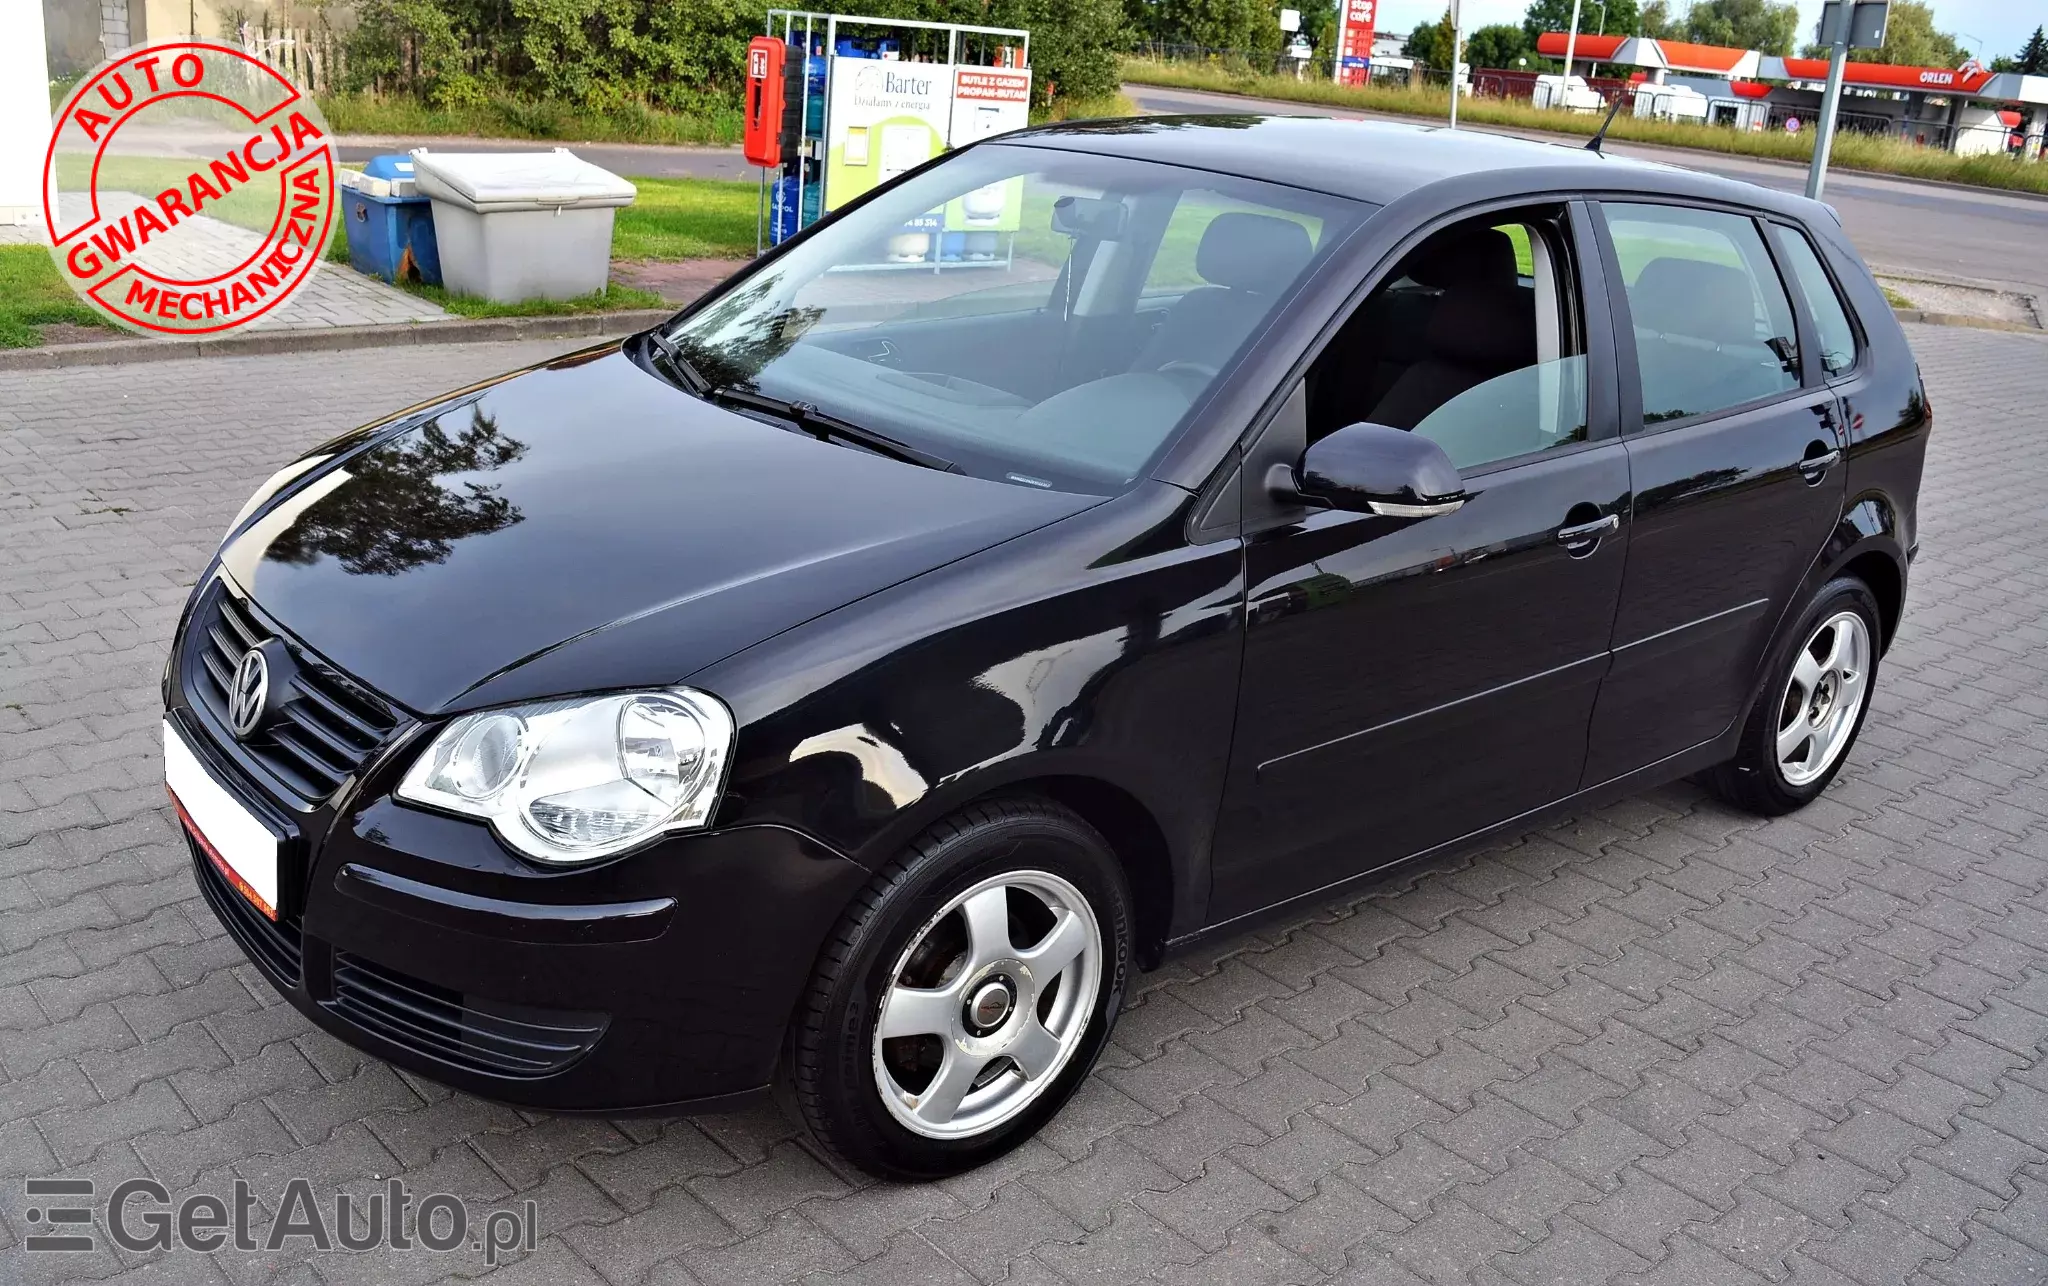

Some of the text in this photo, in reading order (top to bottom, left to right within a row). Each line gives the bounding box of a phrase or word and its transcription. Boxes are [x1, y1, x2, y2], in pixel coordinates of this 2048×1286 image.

[885, 71, 932, 95] Barter
[961, 74, 1027, 88] BUTLE Z GAZEM
[1920, 72, 1953, 84] ORLEN
[957, 86, 1027, 100] PROPAN-BUTAN
